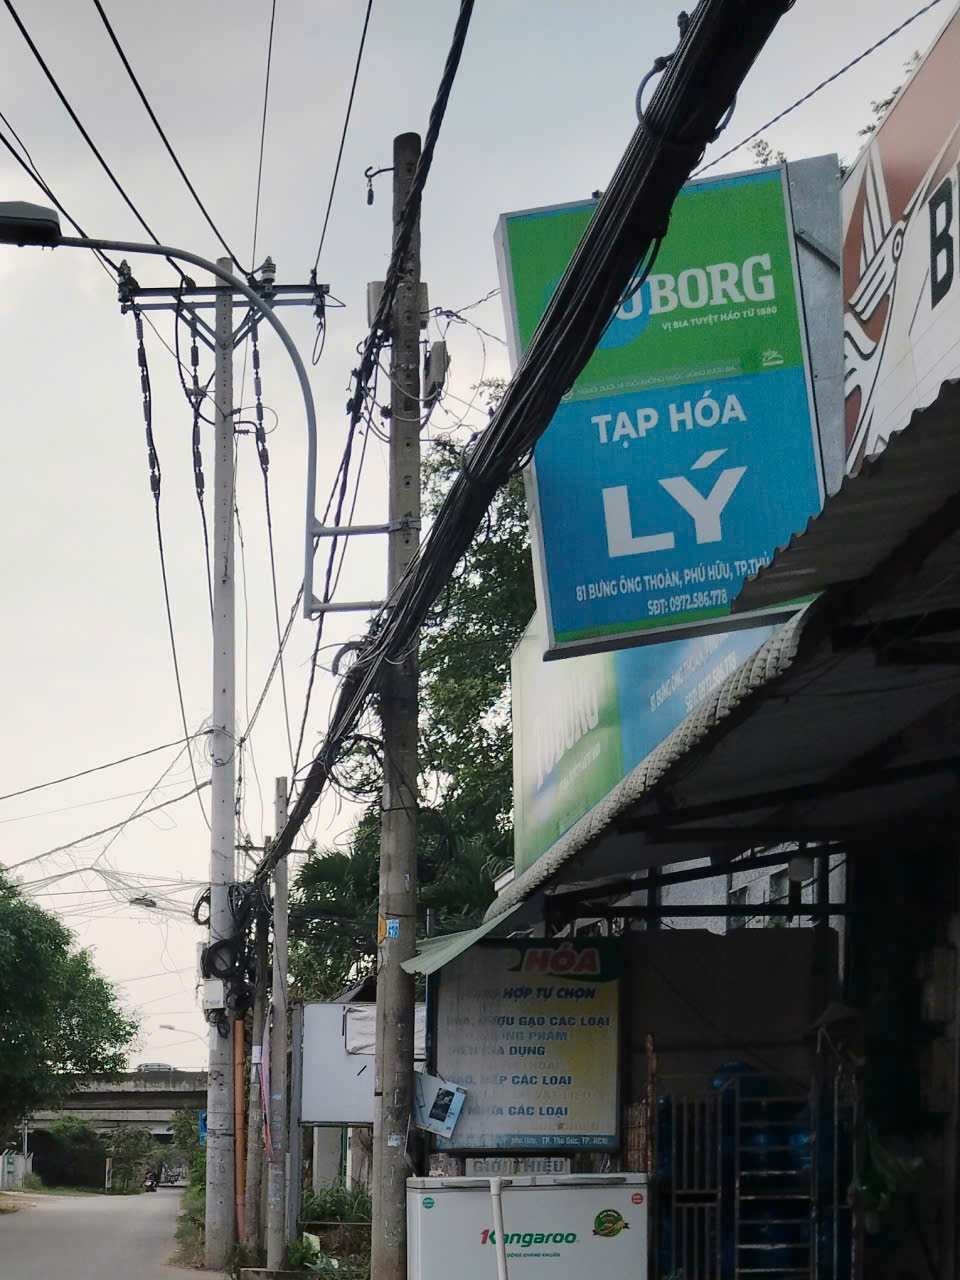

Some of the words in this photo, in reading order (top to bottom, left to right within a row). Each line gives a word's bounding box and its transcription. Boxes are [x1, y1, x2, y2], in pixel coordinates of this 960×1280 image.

[928, 170, 960, 311] B
[615, 253, 775, 320] UBORG
[756, 305, 778, 315] 1880
[591, 408, 659, 448] TẠP
[668, 390, 747, 432] HÓA
[602, 448, 748, 558] LÝ
[576, 585, 587, 601] 81
[589, 579, 618, 599] BƯNG
[619, 575, 642, 594] ÔNG
[643, 568, 682, 591] THOÀN,
[684, 563, 706, 584] PHÚ
[707, 560, 733, 582] HỮU,
[648, 600, 669, 616] SĐT:
[669, 589, 728, 612] 0972.586.778
[557, 987, 596, 1000] CHỌN
[519, 1016, 545, 1028] GẠO
[581, 1016, 609, 1028] LOẠI
[509, 1046, 545, 1058] DỤNG
[511, 1073, 538, 1085] CÁC
[542, 1075, 572, 1087] LOẠI
[508, 1105, 535, 1116] CÁC
[539, 1106, 568, 1118] LOẠI
